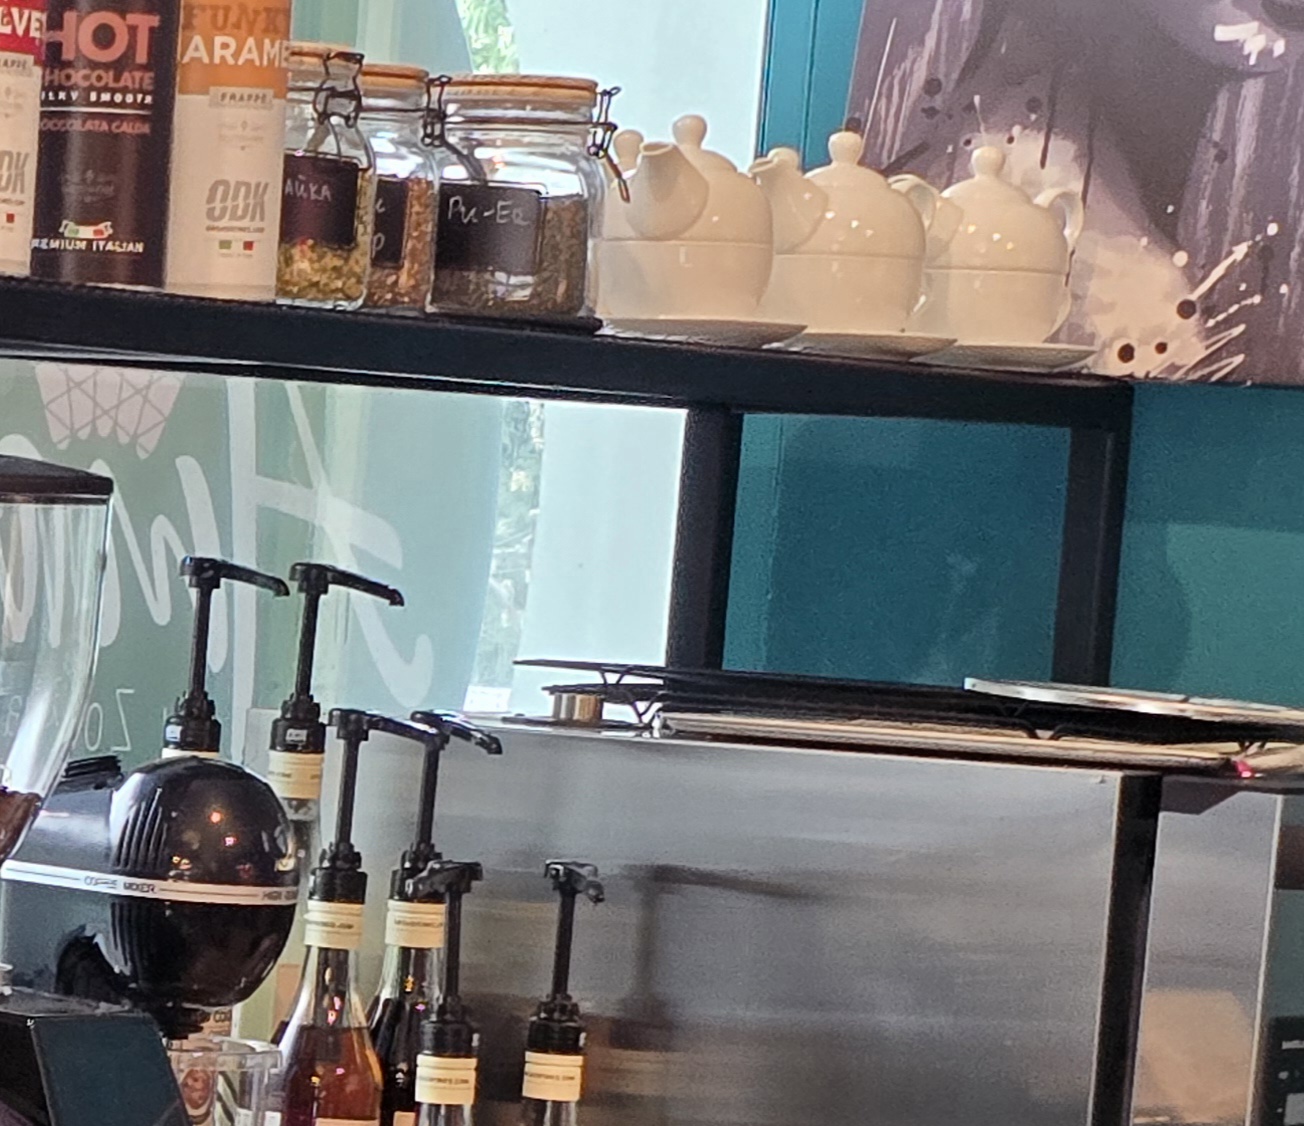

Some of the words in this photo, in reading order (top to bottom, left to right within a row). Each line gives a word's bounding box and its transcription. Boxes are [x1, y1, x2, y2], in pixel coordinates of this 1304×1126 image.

[183, 3, 288, 33] FUNK
[43, 10, 160, 64] HOT
[44, 69, 155, 90] HOCOLATE
[41, 91, 79, 101] ILKY
[40, 118, 109, 133] OCCOLATA
[285, 174, 332, 201] АЙКА
[206, 179, 269, 222] ODK
[31, 238, 87, 251] REMIUM
[93, 240, 145, 253] ITALIAN
